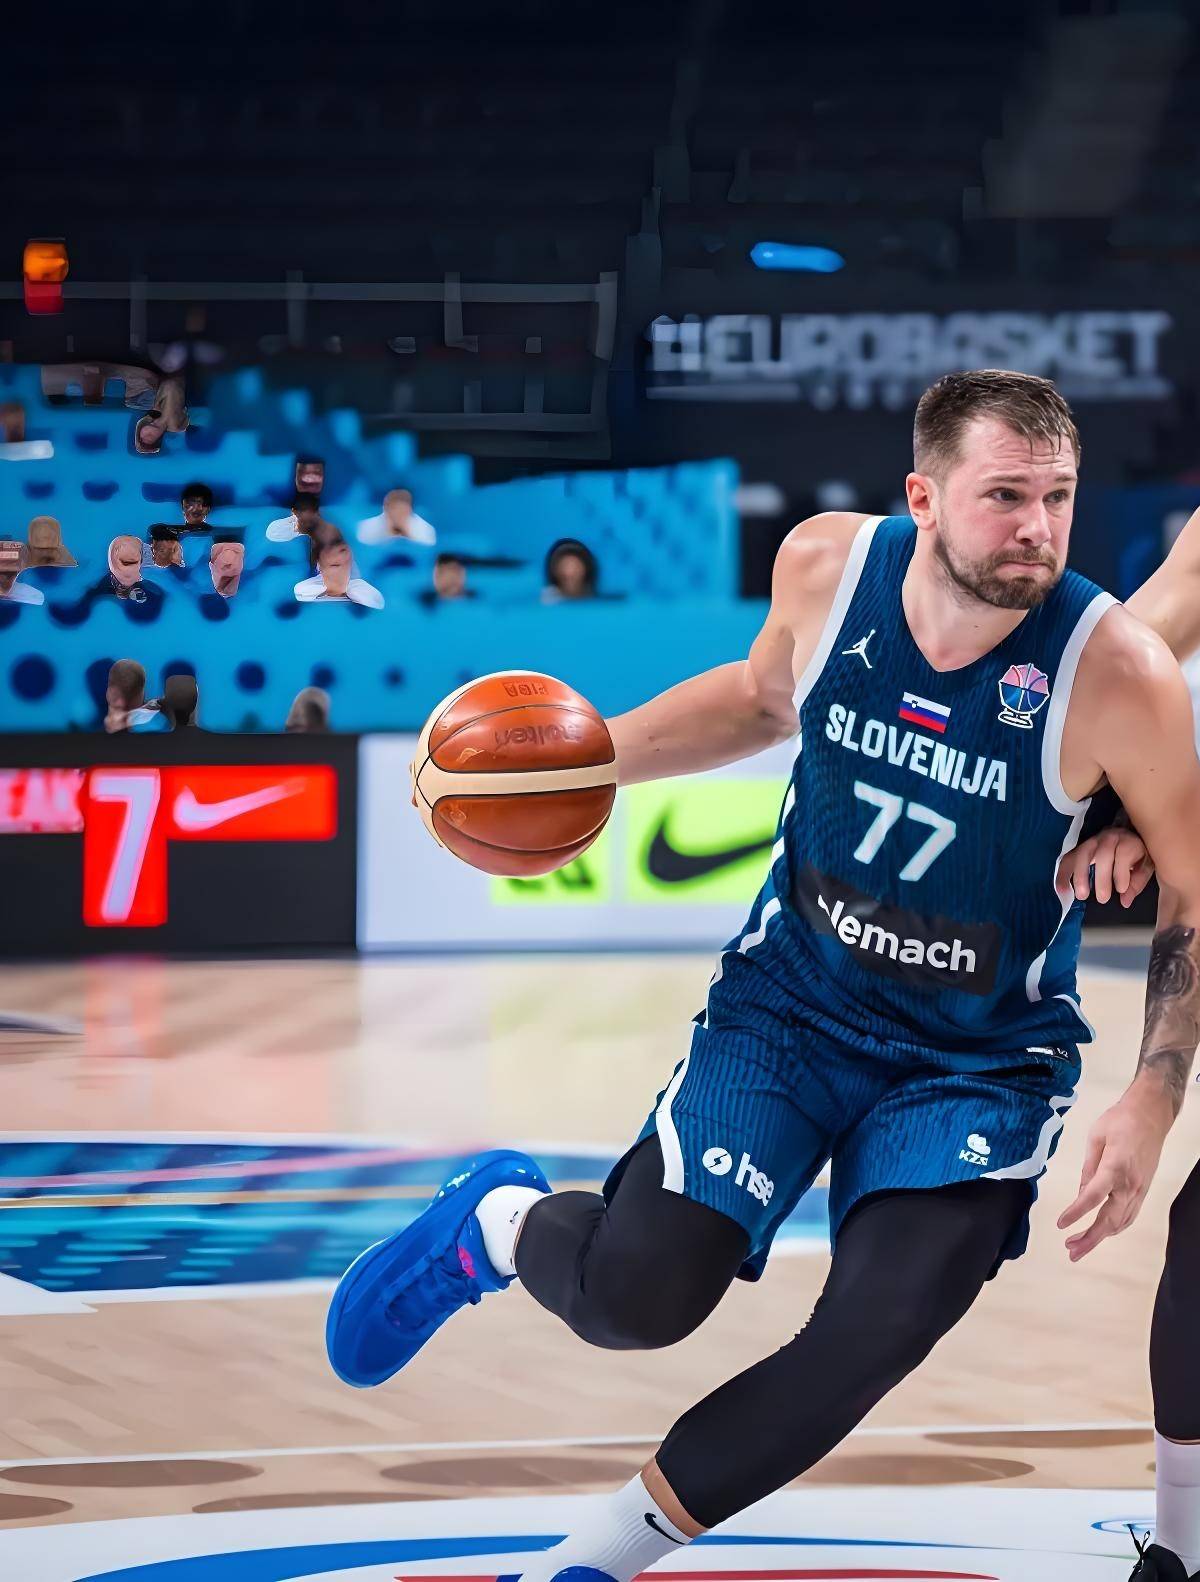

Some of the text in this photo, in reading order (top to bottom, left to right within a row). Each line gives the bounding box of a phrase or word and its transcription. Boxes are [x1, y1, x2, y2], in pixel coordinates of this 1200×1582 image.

[825, 703, 1007, 801] SLOVENIJA
[90, 769, 160, 923] 7
[853, 780, 957, 882] 77
